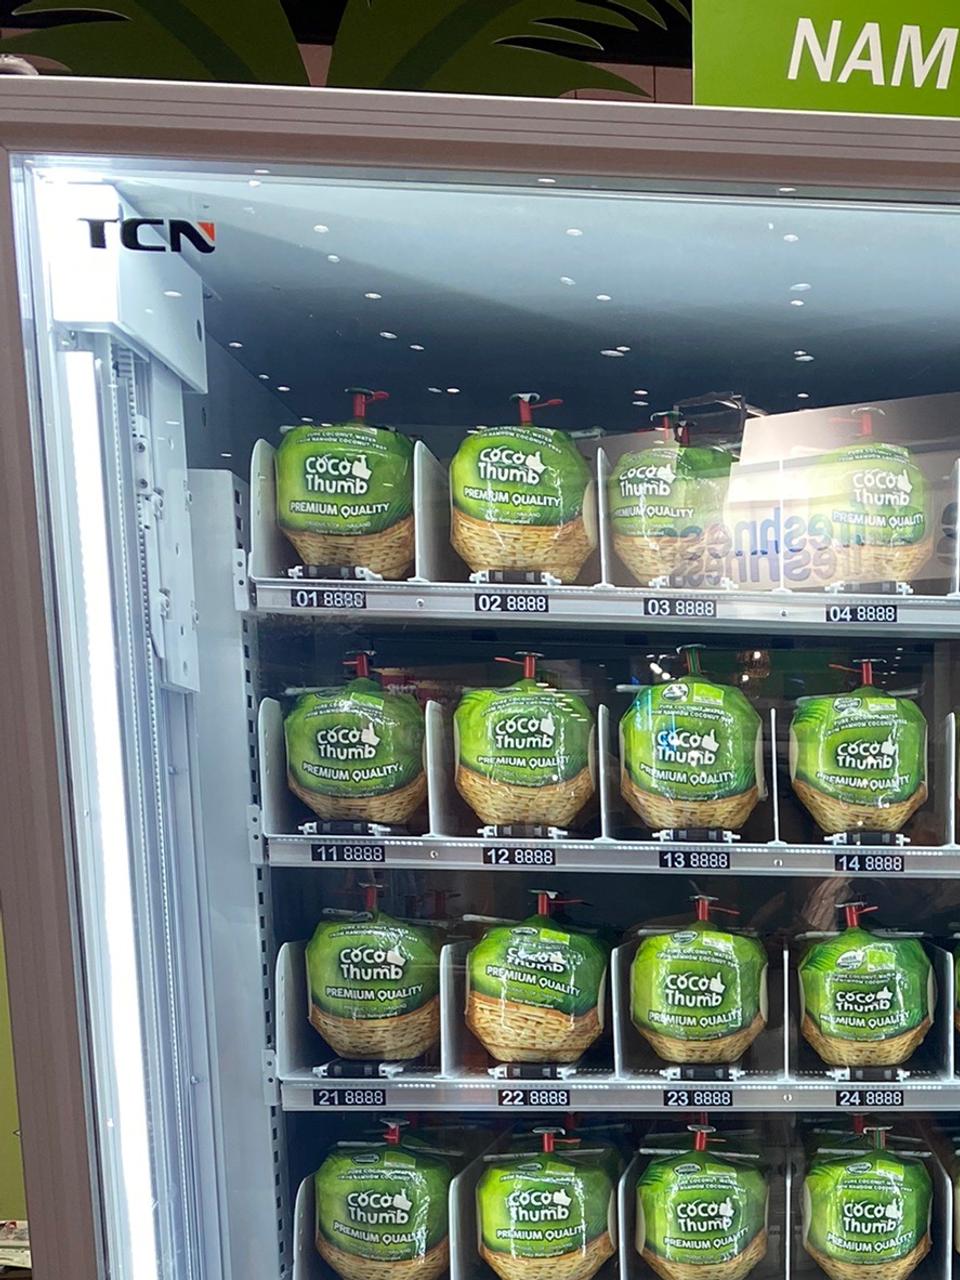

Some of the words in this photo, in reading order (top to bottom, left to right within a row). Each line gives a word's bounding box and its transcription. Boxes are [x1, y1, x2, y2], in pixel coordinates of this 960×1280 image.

[786, 17, 960, 91] NAM
[77, 217, 216, 254] TCN
[478, 461, 540, 485] Thumb
[306, 473, 368, 495] Thumb
[463, 487, 508, 505] PREMIUM
[511, 490, 561, 508] QUALITY
[289, 502, 338, 517] PREMIUM
[340, 503, 390, 518] QUALITY
[296, 591, 318, 608] 01
[478, 593, 502, 611] 02
[648, 599, 670, 615] 03
[830, 606, 852, 622] 04
[318, 741, 376, 760] Thumb
[302, 762, 350, 781] PREMIUM
[352, 763, 400, 782] QUALITY
[487, 848, 509, 864] 12
[663, 853, 685, 868] 13
[839, 856, 861, 871] 14
[341, 963, 403, 981] Thumb
[326, 986, 375, 1002] PREMIUM
[377, 984, 424, 1002] QUALITY
[502, 1091, 524, 1105] 22
[667, 1091, 689, 1106] 23
